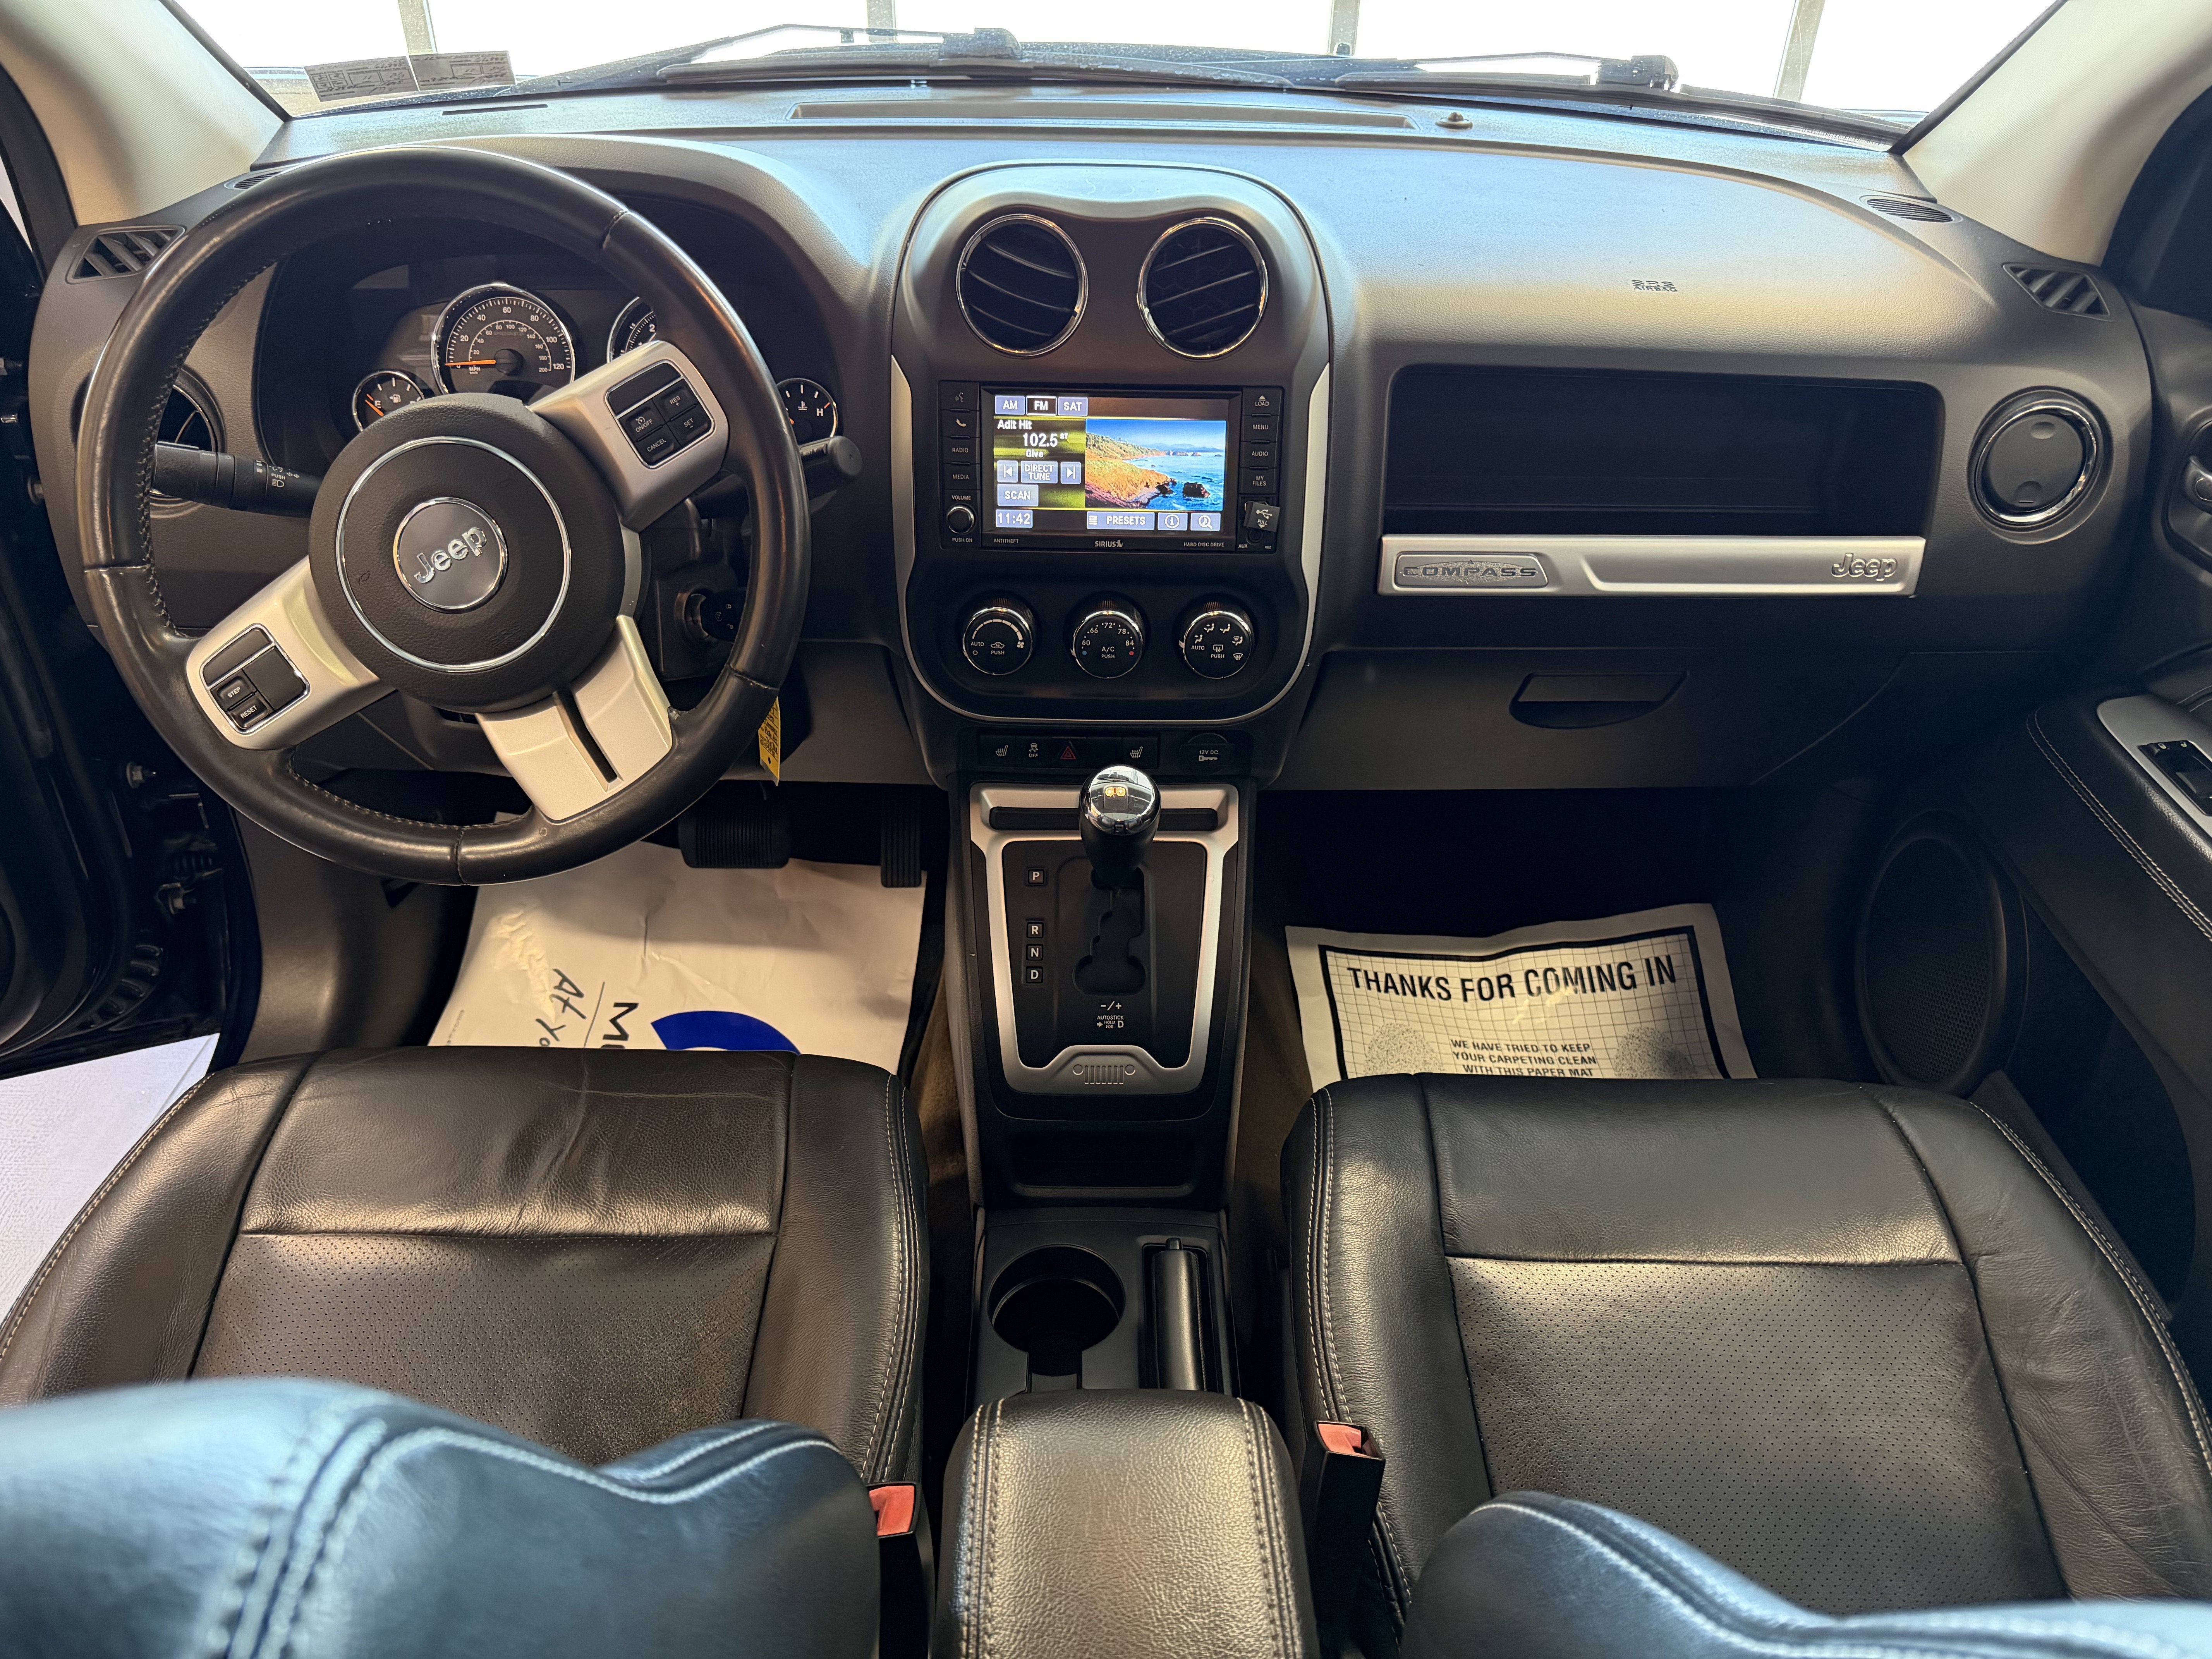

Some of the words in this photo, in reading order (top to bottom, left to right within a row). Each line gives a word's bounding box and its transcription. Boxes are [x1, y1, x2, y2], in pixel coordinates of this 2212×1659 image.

[649, 324, 655, 332] 2
[375, 400, 381, 408] E
[670, 395, 681, 405] RES
[1003, 400, 1018, 410] AM
[1034, 400, 1048, 410] FM
[1063, 402, 1082, 411] SAT
[816, 408, 823, 416] H
[635, 418, 653, 433] ON/OFF
[684, 418, 694, 428] SET
[1023, 432, 1058, 447] 102.5
[647, 438, 666, 452] CANCEL
[1025, 449, 1044, 458] Give
[1024, 464, 1054, 472] DIRECT
[1028, 472, 1050, 481] TUNE
[1005, 491, 1031, 500] SCAN
[998, 512, 1031, 525] 11:42
[1106, 515, 1146, 525] PRESETS
[413, 527, 487, 584] Jeep
[1403, 567, 1538, 577] COMPASS
[1831, 553, 1897, 581] Jeep
[227, 687, 240, 698] STEP
[240, 705, 257, 719] RESET
[1032, 872, 1040, 881] P
[1031, 925, 1039, 935] R
[1030, 948, 1039, 957] N
[1030, 970, 1039, 979] D
[1346, 967, 1452, 1001] THANKS
[1460, 973, 1515, 1003] FOR
[1524, 961, 1637, 997] COMING
[1644, 954, 1676, 986] IN
[600, 1002, 639, 1049] M
[1117, 1020, 1124, 1028] D
[1451, 1039, 1468, 1048] WE
[1472, 1042, 1502, 1051] HAVE
[1506, 1044, 1539, 1053] TRIED
[1543, 1044, 1558, 1053] TO
[1562, 1043, 1590, 1053] KEEP
[1452, 1051, 1485, 1062] YOUR
[1489, 1055, 1554, 1065] CARPETING
[1558, 1056, 1597, 1065] CLEAN
[1463, 1065, 1493, 1075] WITH
[1495, 1067, 1523, 1076] THIS
[1527, 1068, 1565, 1077] PAPER
[1568, 1068, 1593, 1077] MAT
